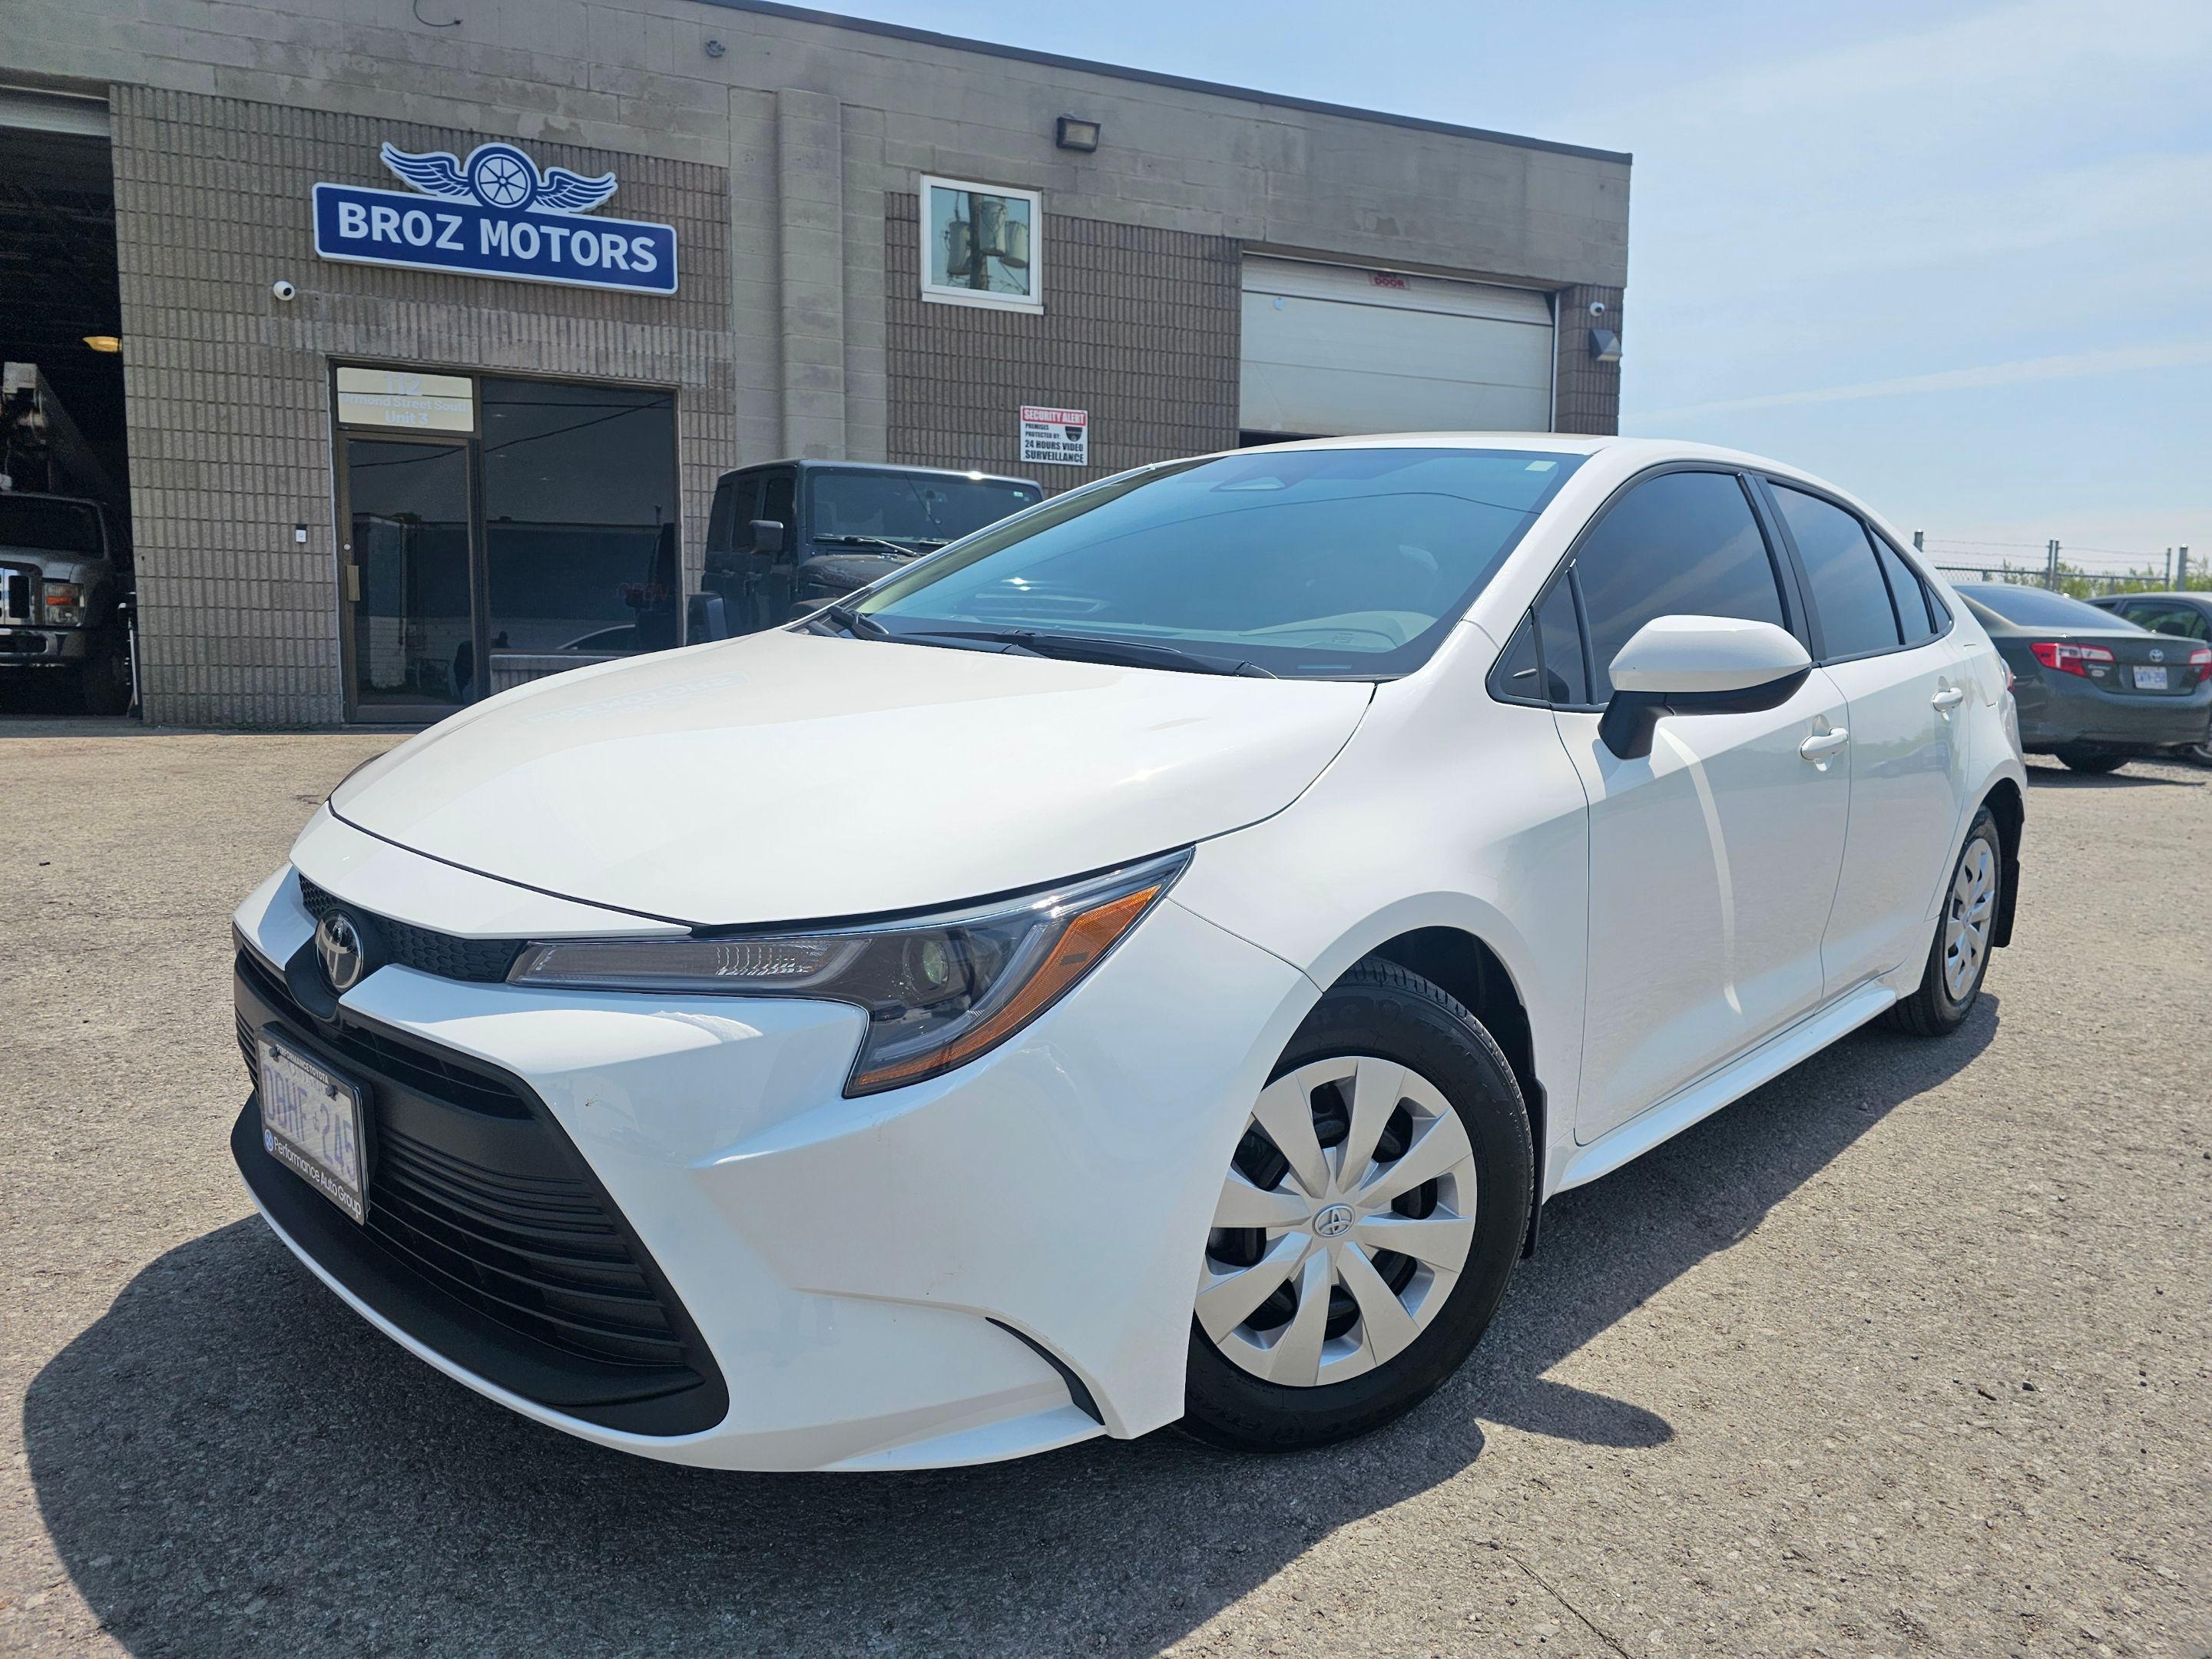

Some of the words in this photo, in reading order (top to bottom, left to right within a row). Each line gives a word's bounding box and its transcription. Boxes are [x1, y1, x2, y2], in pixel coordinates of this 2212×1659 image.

[338, 200, 464, 250] BROZ
[480, 218, 658, 273] MOTORS
[383, 373, 422, 396] 112
[392, 396, 431, 409] Street
[386, 410, 417, 425] Unit
[419, 412, 429, 426] 3
[1024, 409, 1062, 422] SECURITY
[1062, 412, 1084, 424] ALERT
[1025, 439, 1035, 448] 24
[1035, 440, 1061, 450] HOURS
[1062, 442, 1084, 452] VIDEO
[1025, 449, 1084, 463] SURVEILLANCE
[309, 1065, 329, 1084] TOYOTA
[273, 1136, 320, 1183] Performance
[320, 1171, 338, 1197] Auto
[337, 1185, 362, 1219] Group
